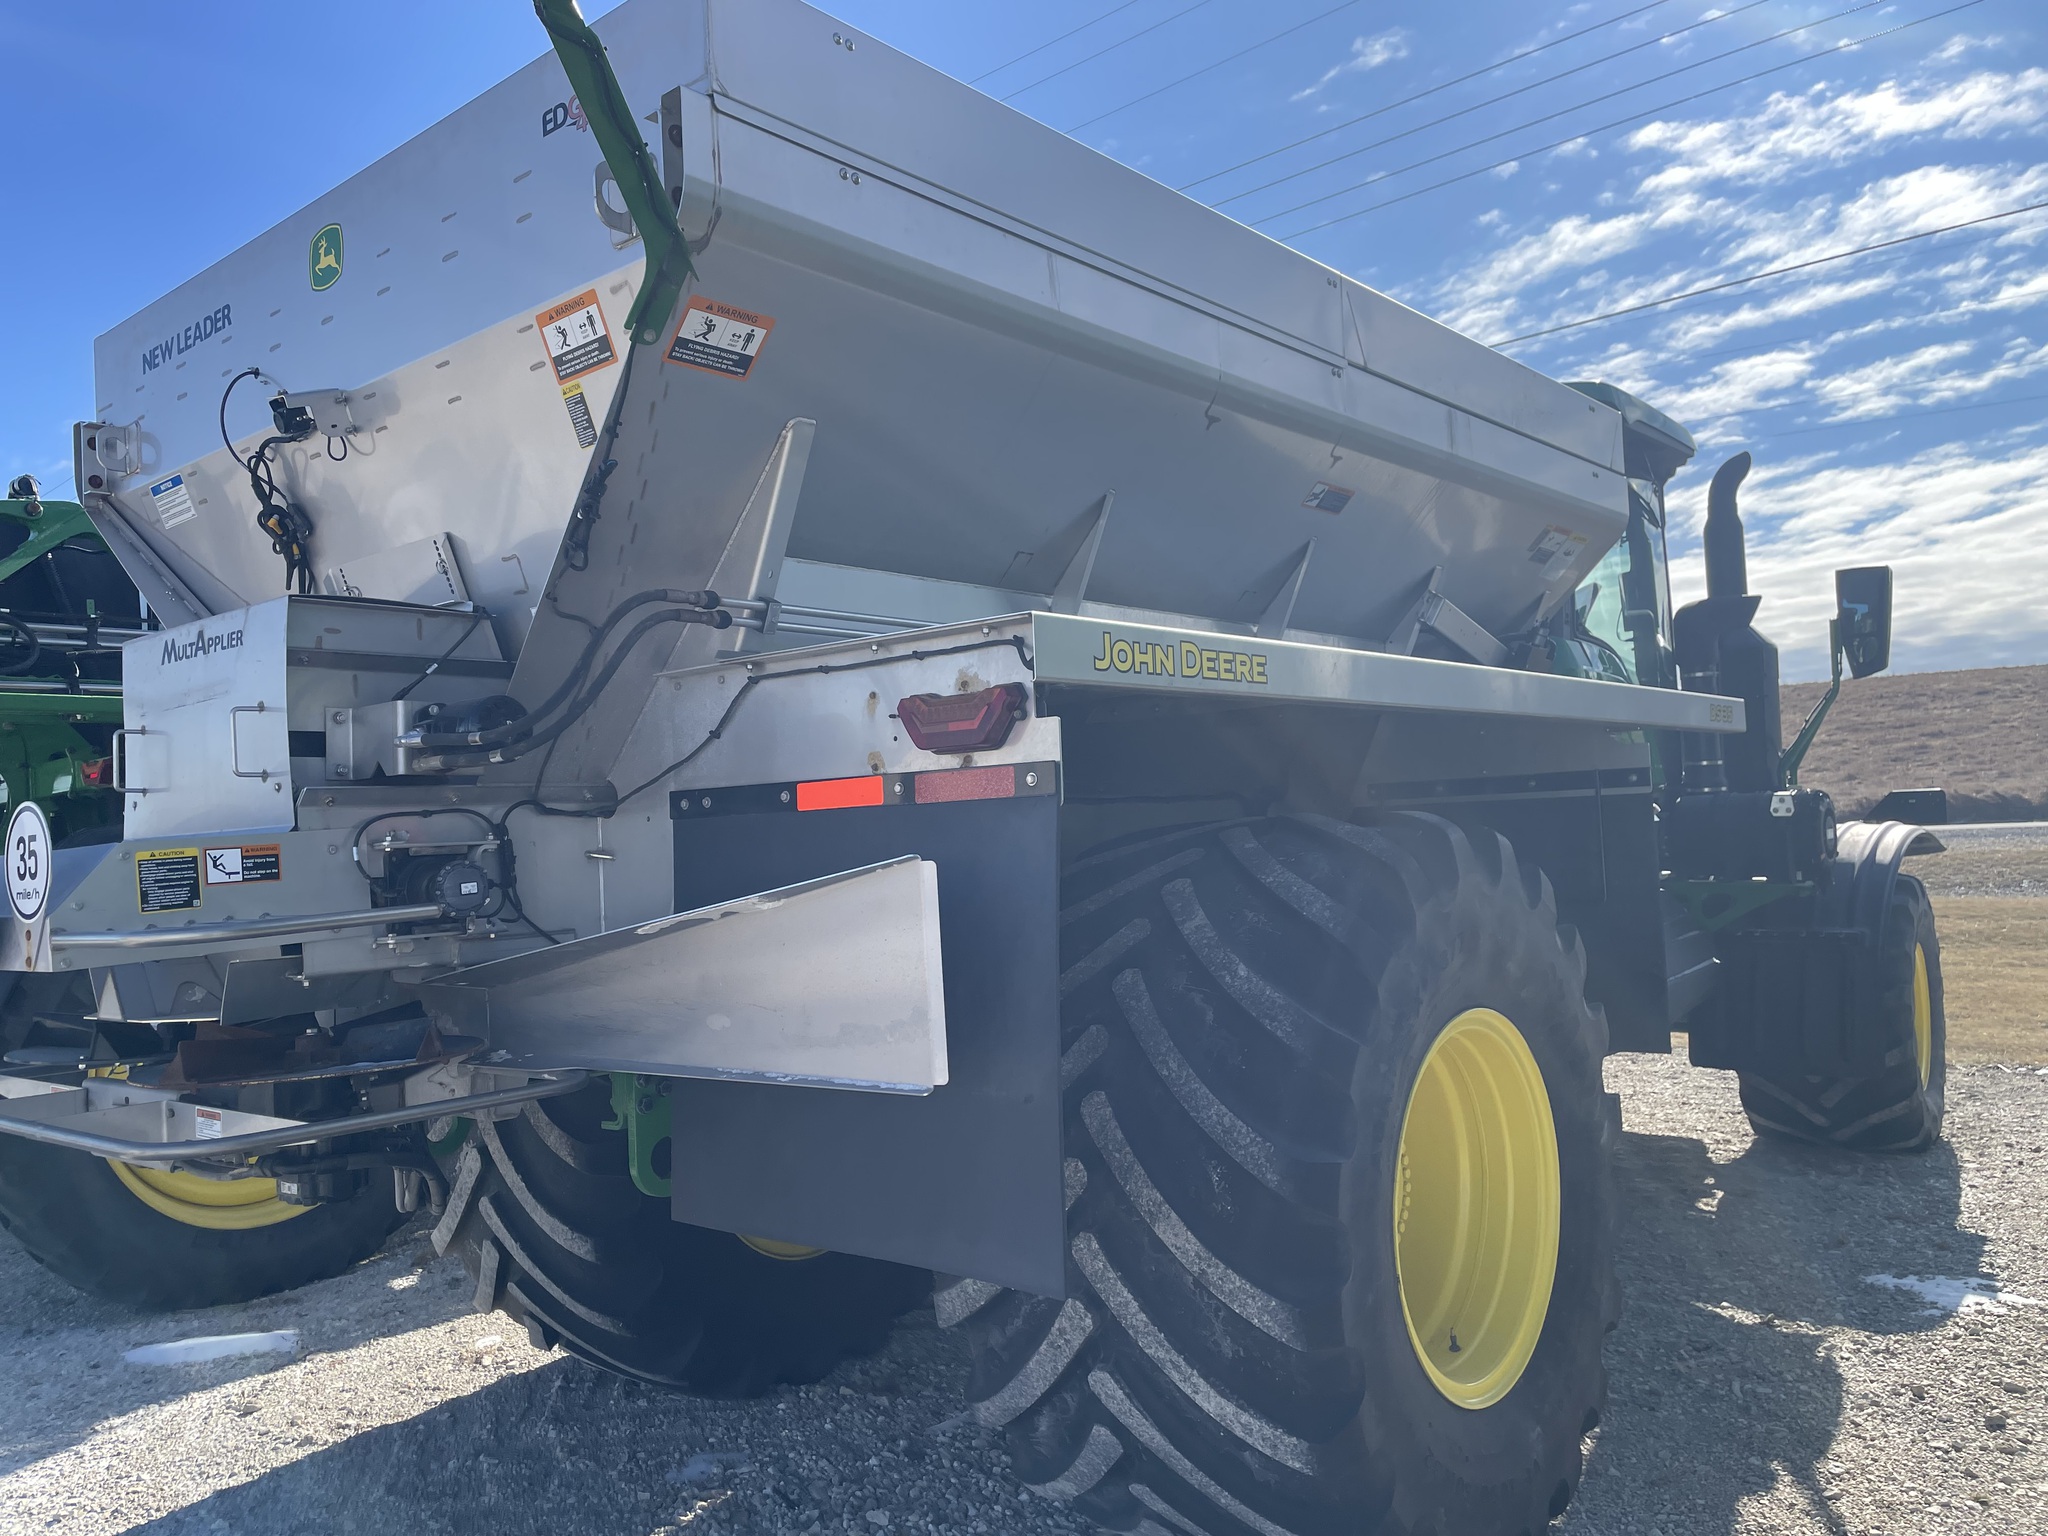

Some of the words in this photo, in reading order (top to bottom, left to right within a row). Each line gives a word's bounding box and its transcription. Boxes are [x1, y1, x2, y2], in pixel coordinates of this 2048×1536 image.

[554, 297, 585, 317] WARNING
[716, 306, 759, 323] WARNING
[142, 336, 174, 375] NEW
[176, 303, 232, 356] LEADER
[16, 834, 38, 882] 35
[16, 889, 40, 901] mile/h
